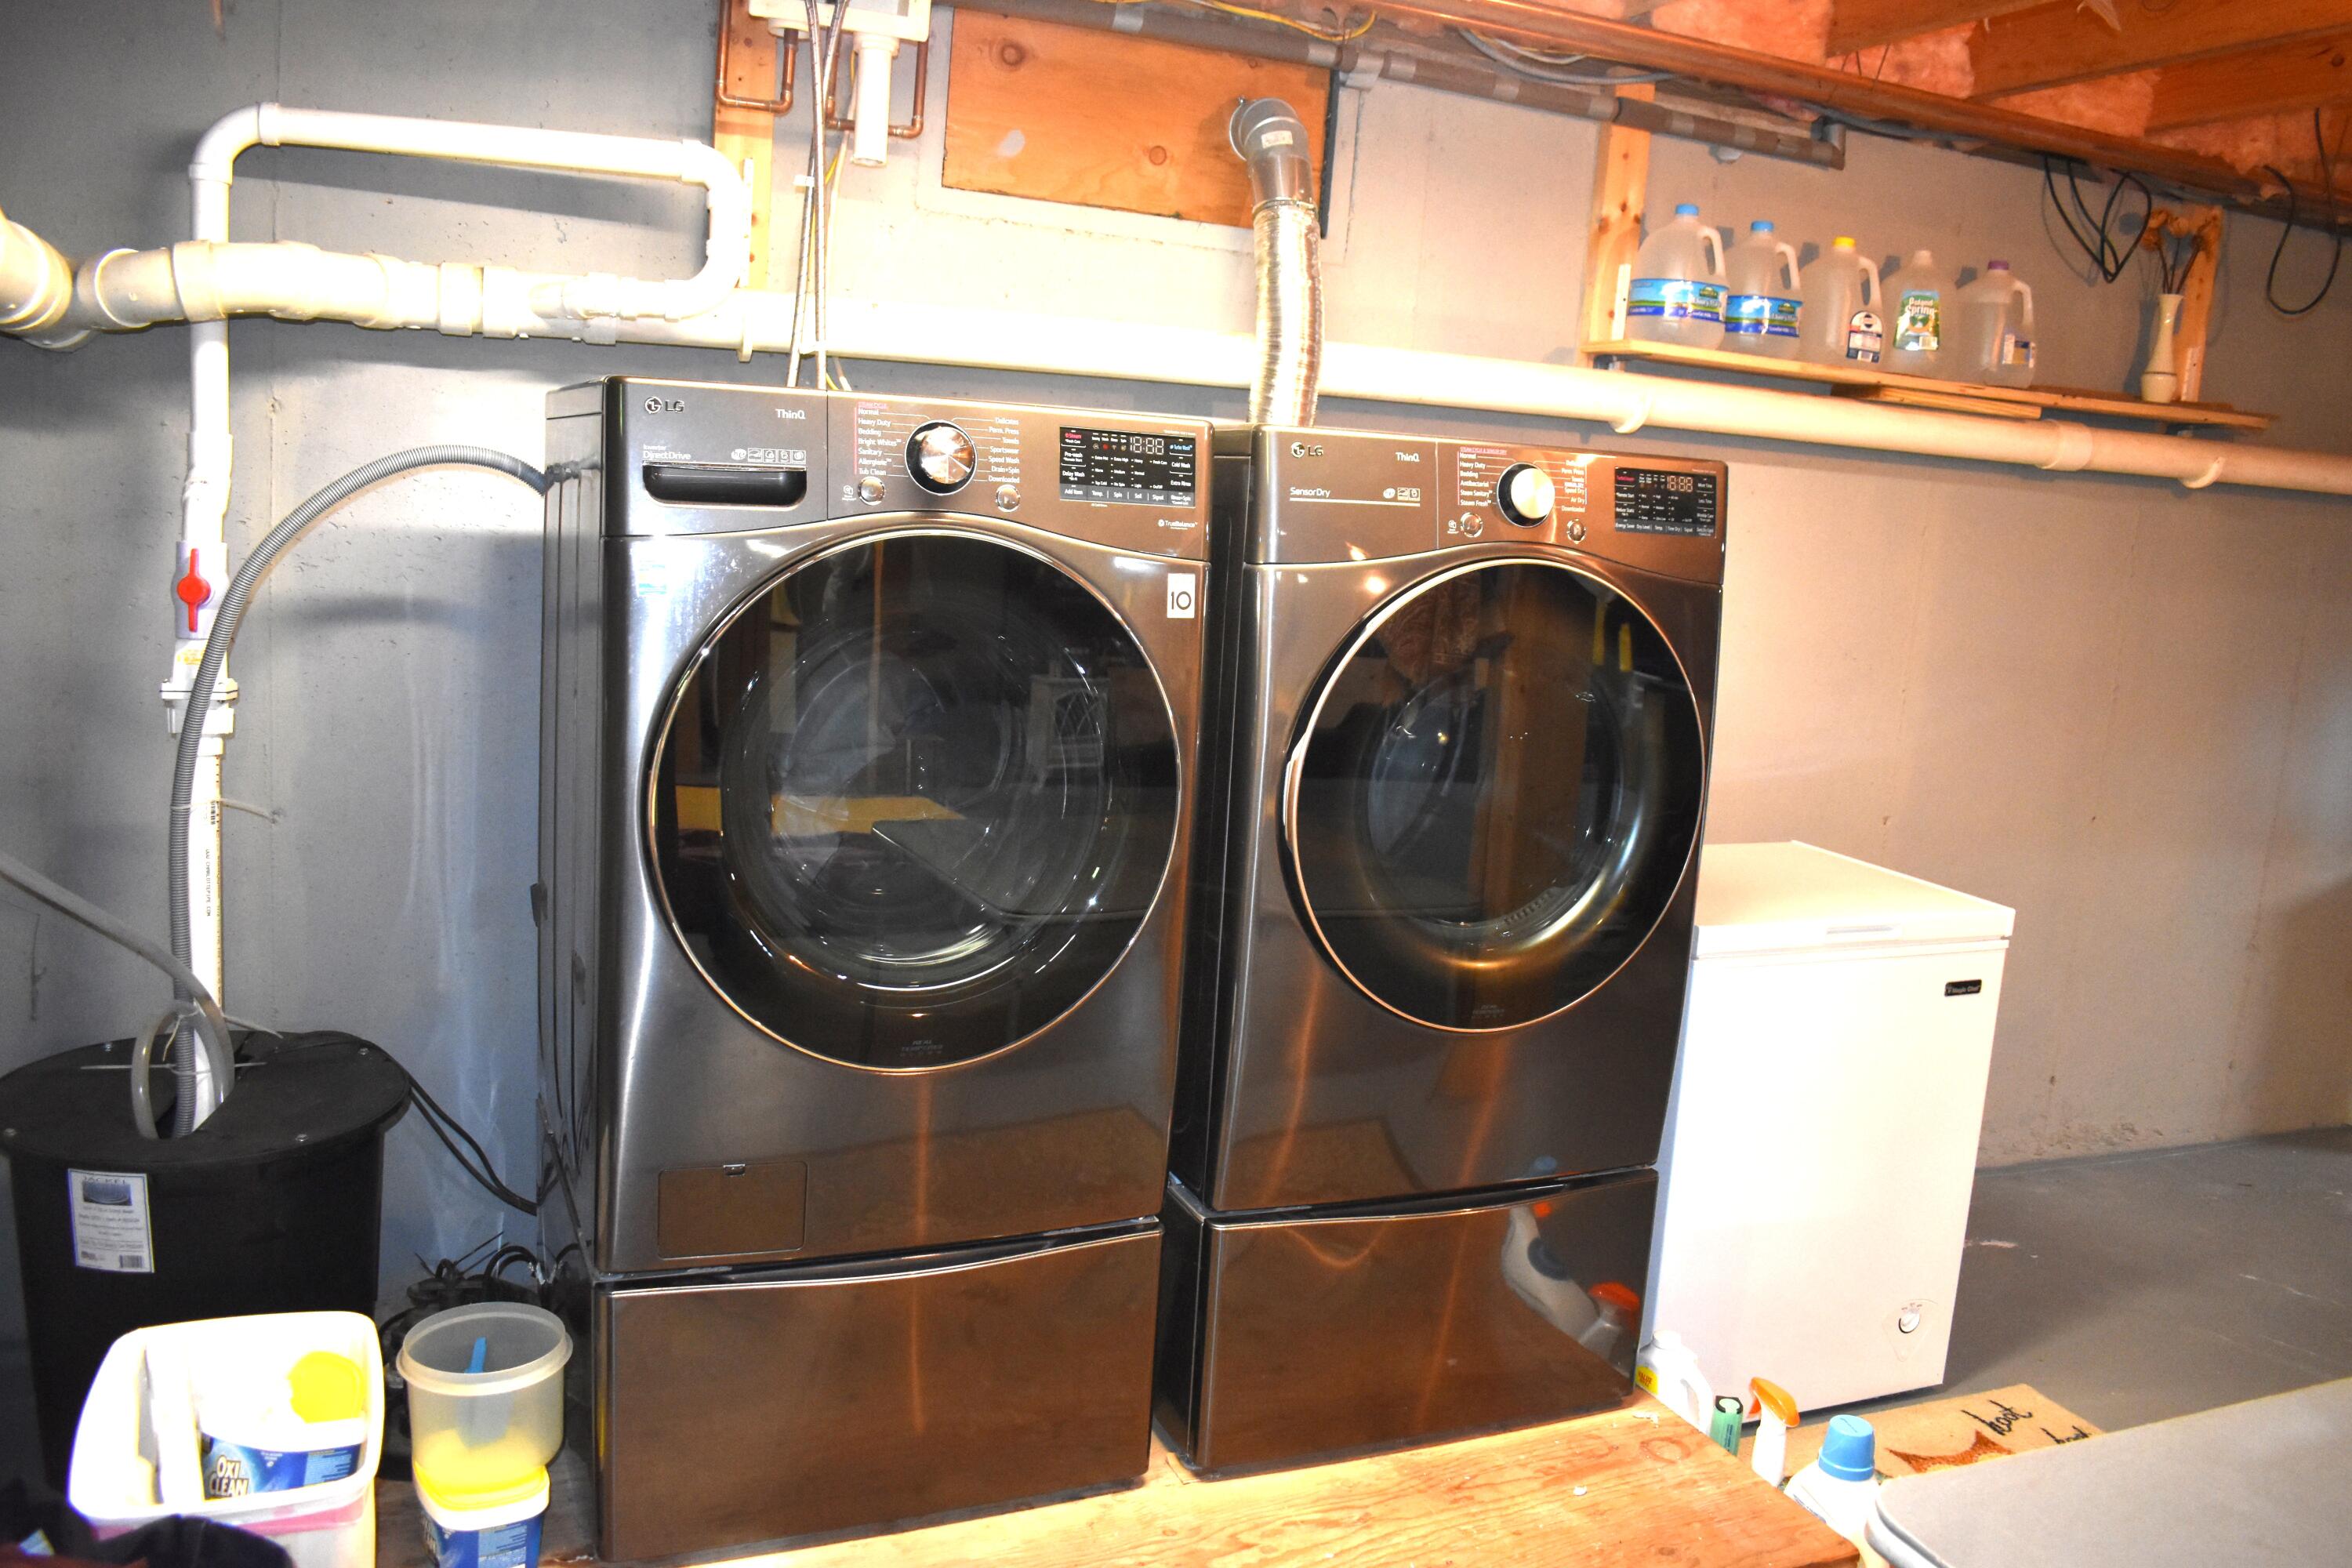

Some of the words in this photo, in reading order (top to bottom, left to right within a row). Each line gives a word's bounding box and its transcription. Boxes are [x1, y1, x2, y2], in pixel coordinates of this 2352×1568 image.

[1909, 297, 1933, 307] Poland
[1904, 304, 1936, 320] Spring
[665, 400, 684, 413] LG
[775, 408, 806, 419] ThinQ
[858, 418, 876, 426] Heavy
[877, 419, 891, 427] Duty
[858, 448, 883, 457] Sanitary
[1307, 445, 1324, 457] LG
[1396, 452, 1420, 462] ThinQ
[1171, 591, 1192, 610] 10
[216, 1454, 241, 1479] OXI
[209, 1473, 249, 1497] CLEAN
